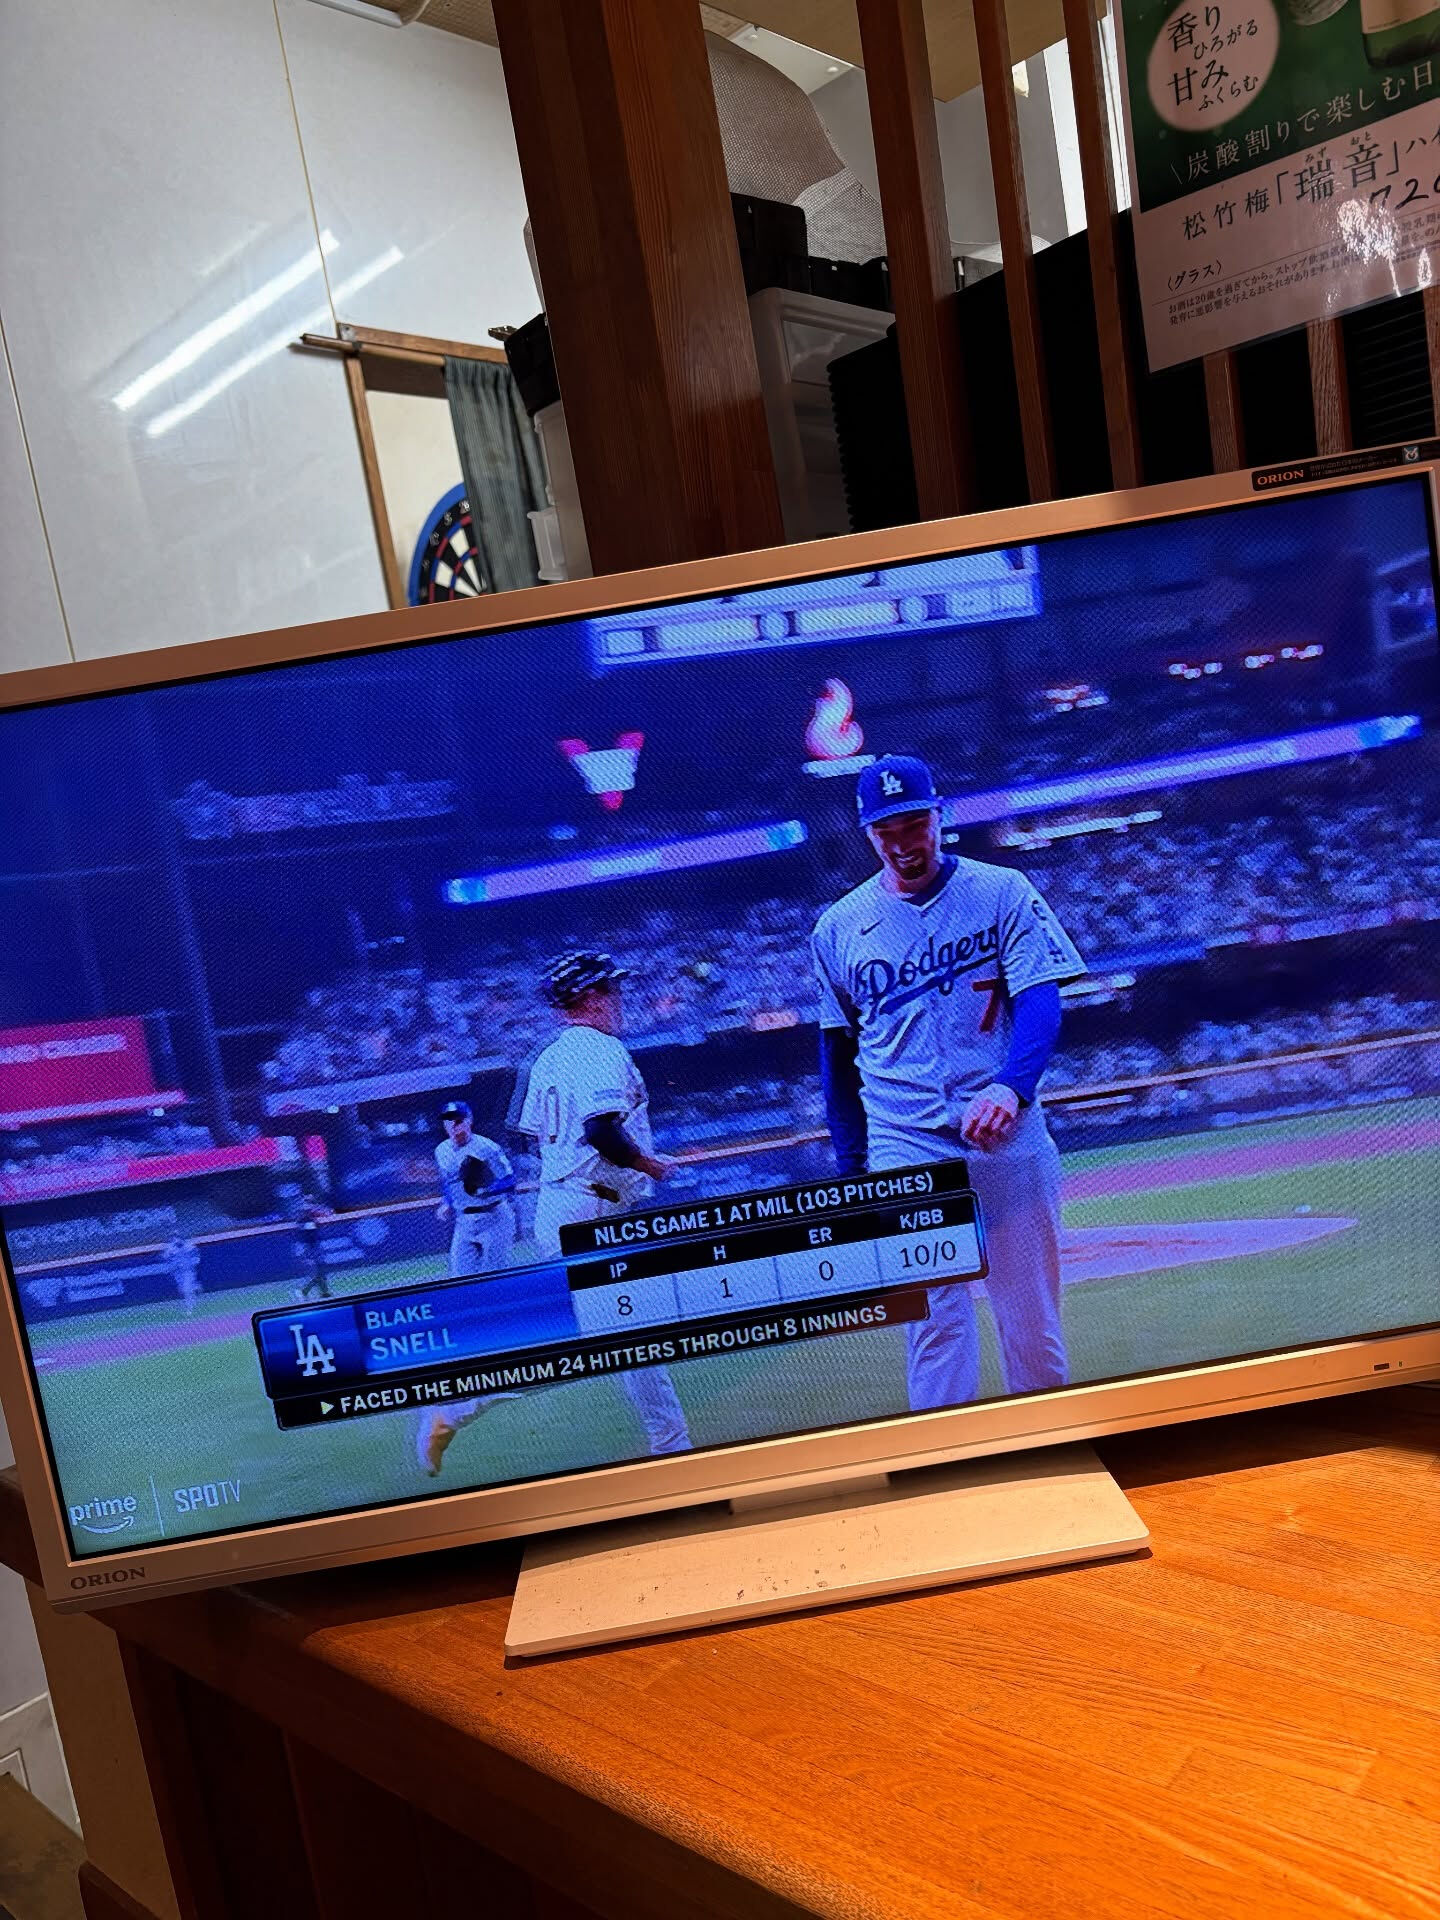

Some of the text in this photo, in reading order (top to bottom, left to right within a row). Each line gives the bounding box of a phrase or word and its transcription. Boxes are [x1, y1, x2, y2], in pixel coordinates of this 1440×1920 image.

[1168, 6, 1220, 52] 香り
[1194, 19, 1258, 60] ひろがる
[1167, 60, 1228, 106] 甘み
[1199, 75, 1258, 111] ふくらむ
[1257, 469, 1304, 486] ORION
[594, 1170, 934, 1247] NLCS GAME 1 AT MIL (103 PITCHES)
[610, 1208, 944, 1279] IP H ER K/BB
[618, 1240, 957, 1316] 8 1 0 10/0
[365, 1304, 433, 1330] BLAKE
[290, 1324, 336, 1376] LA
[340, 1304, 888, 1414] FACED THE MINIMUM 24 HITTERS THROUGH 8 INNINGS
[371, 1328, 457, 1360] SNELL
[69, 1494, 137, 1527] prime
[70, 1566, 146, 1592] ORION
